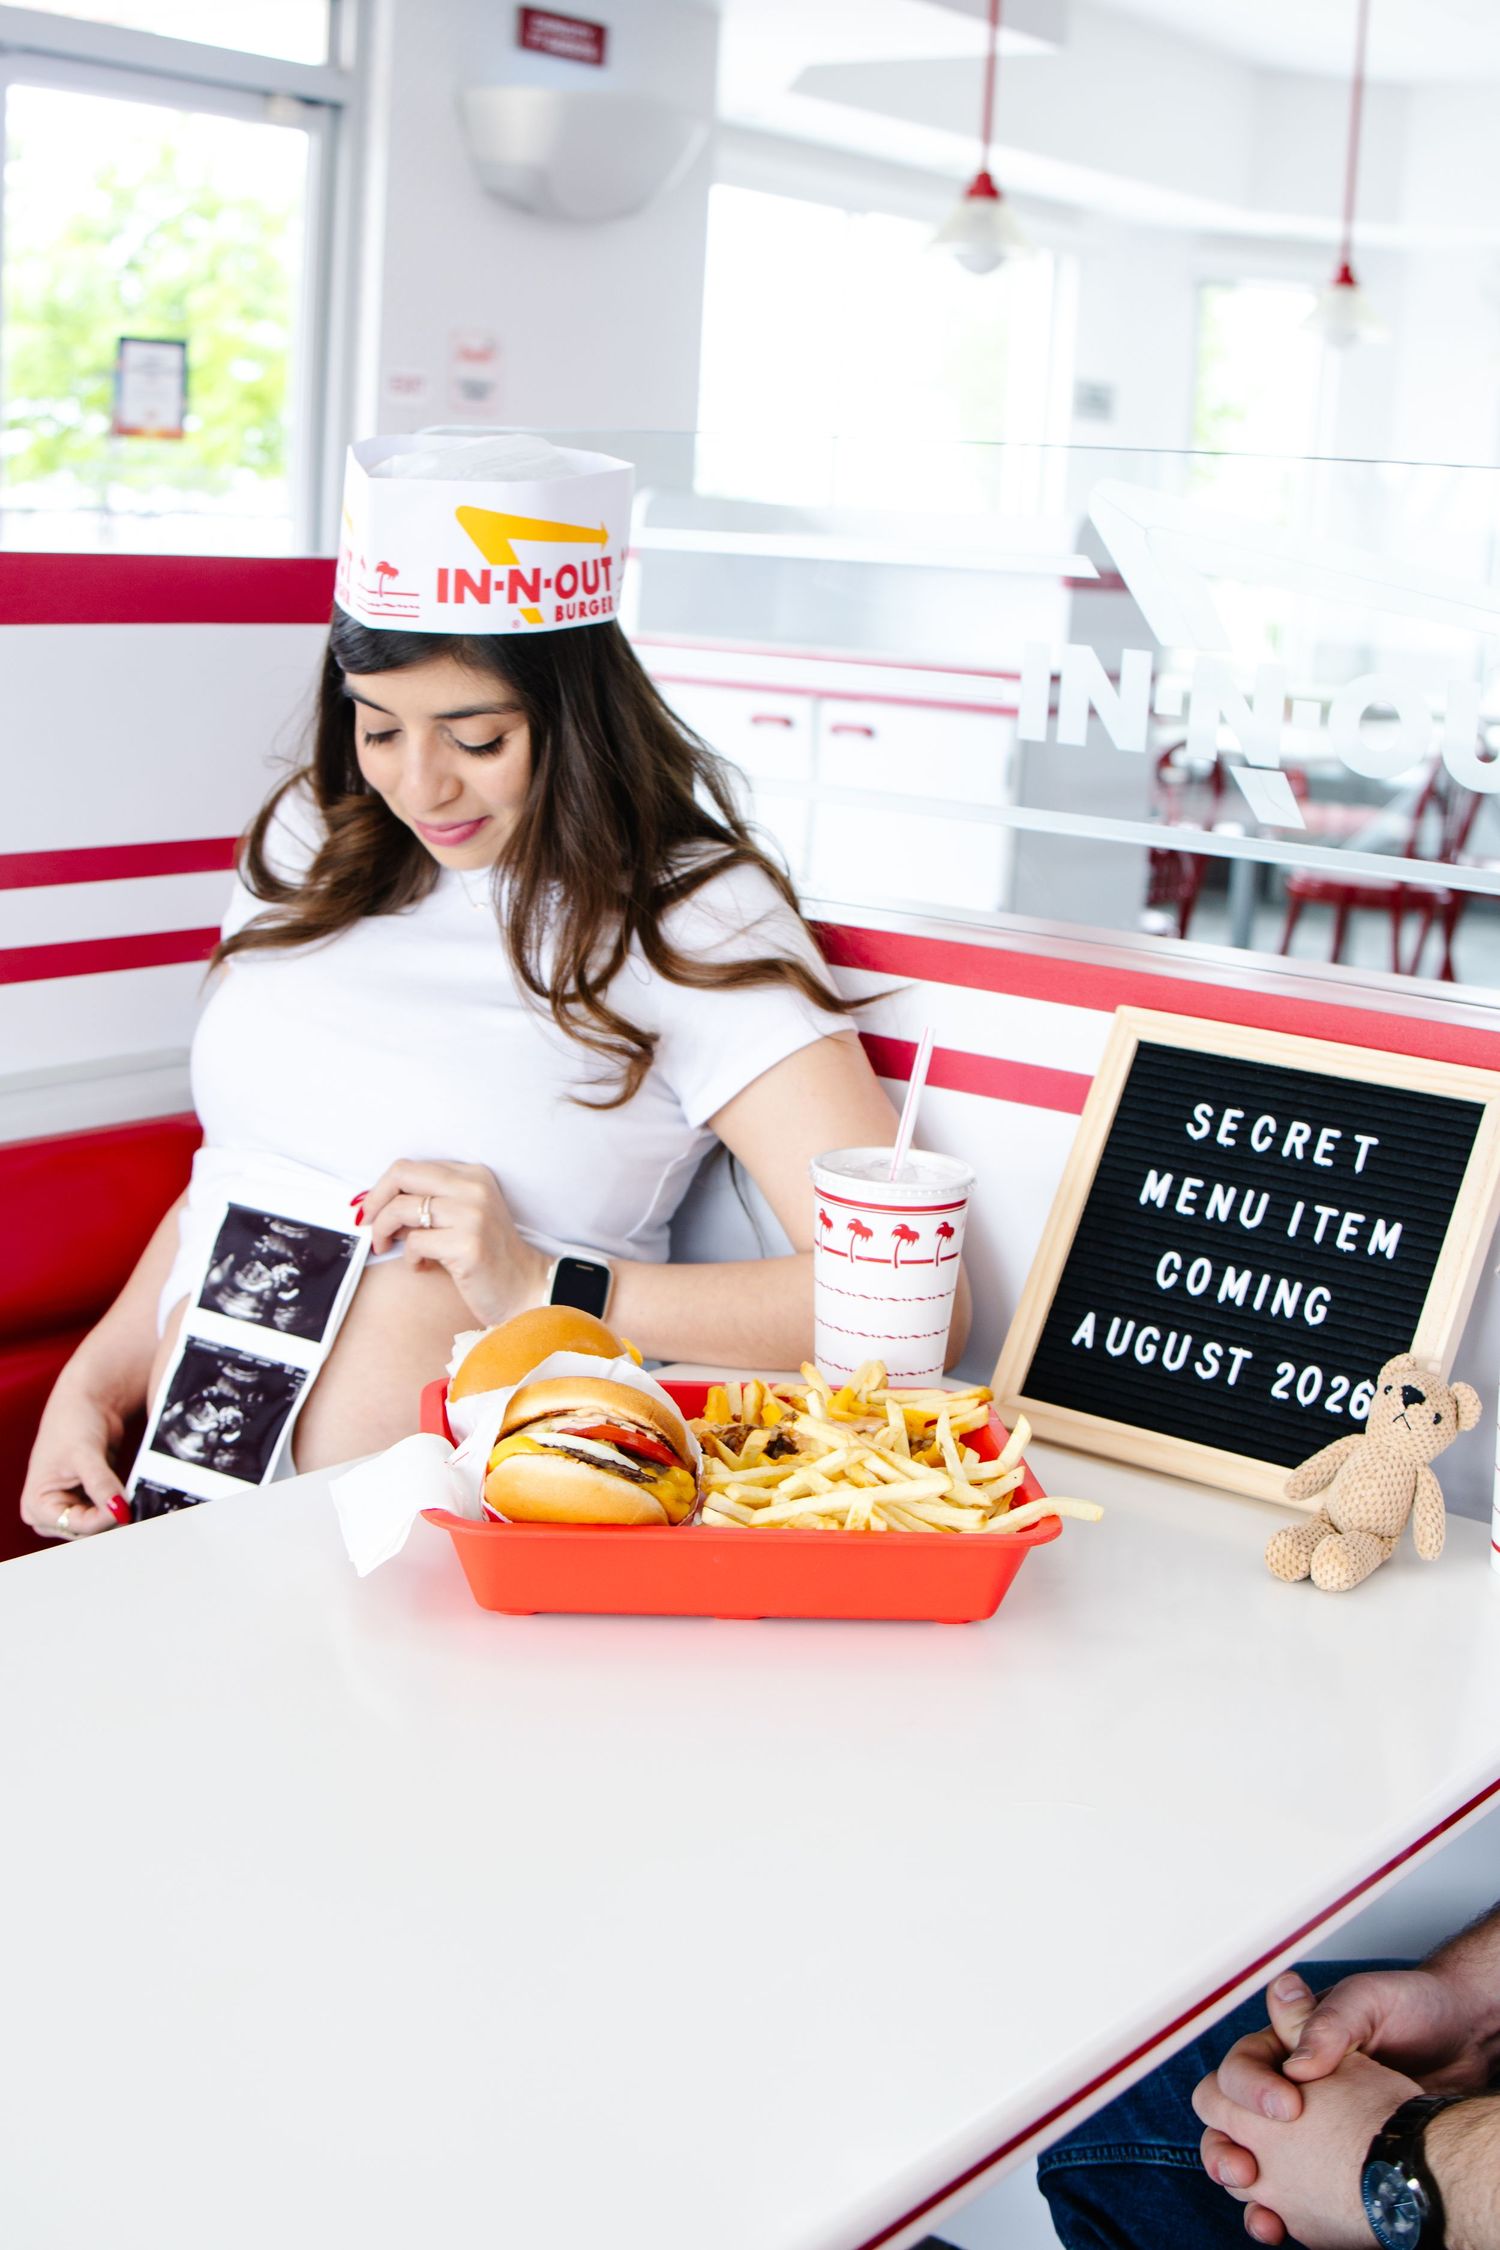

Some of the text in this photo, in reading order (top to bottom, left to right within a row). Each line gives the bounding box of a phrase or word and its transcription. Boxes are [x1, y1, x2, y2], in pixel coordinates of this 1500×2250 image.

[437, 556, 612, 605] IN-N-OUT
[554, 596, 613, 622] BURGER
[1186, 1103, 1379, 1174] SECRET
[1139, 1169, 1403, 1260] MENU ITEM
[1156, 1251, 1332, 1326] COMING
[1071, 1312, 1376, 1420] AUGUST 2026
